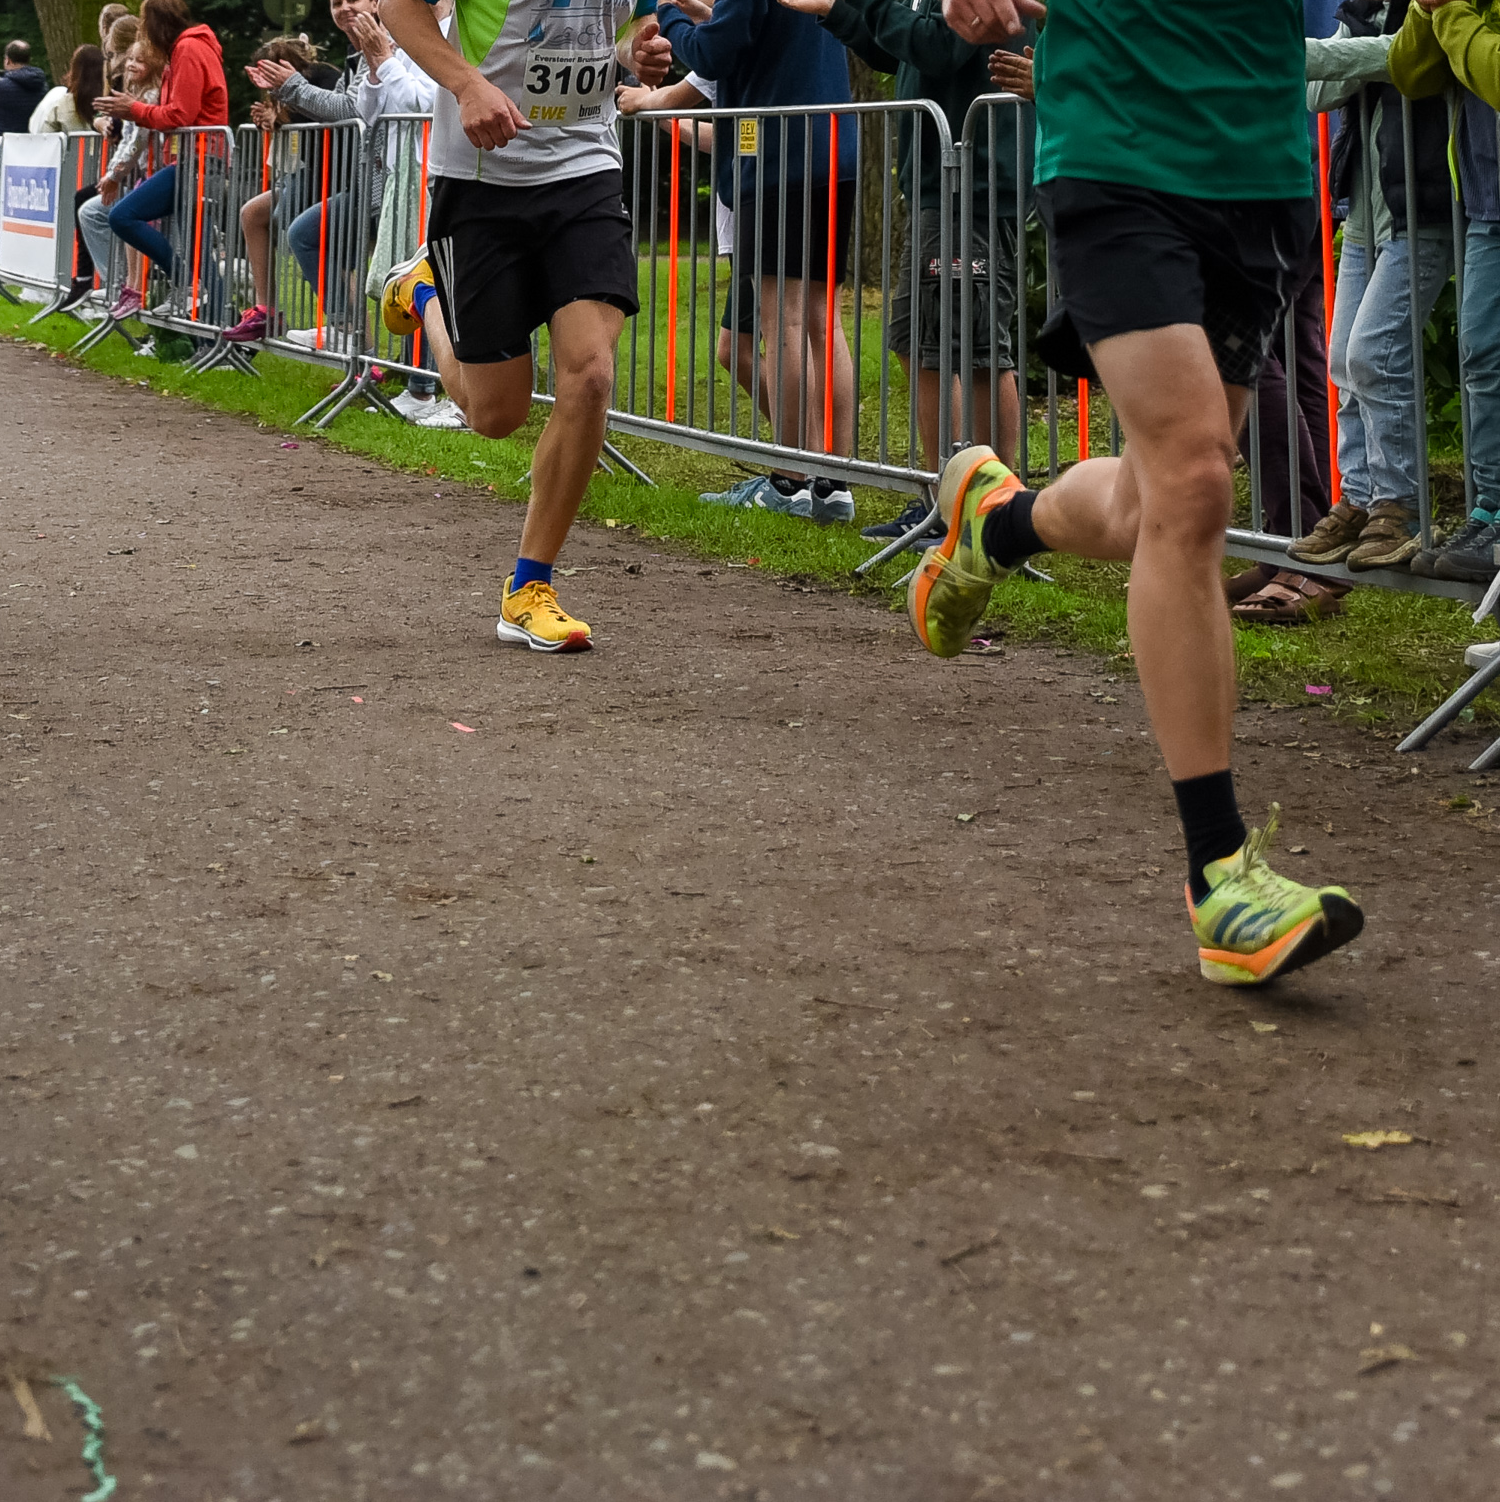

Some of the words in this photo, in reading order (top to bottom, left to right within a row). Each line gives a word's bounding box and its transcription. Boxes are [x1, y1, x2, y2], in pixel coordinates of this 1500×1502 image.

[526, 62, 609, 95] 3101
[529, 105, 568, 121] EWE
[578, 104, 602, 118] bruns
